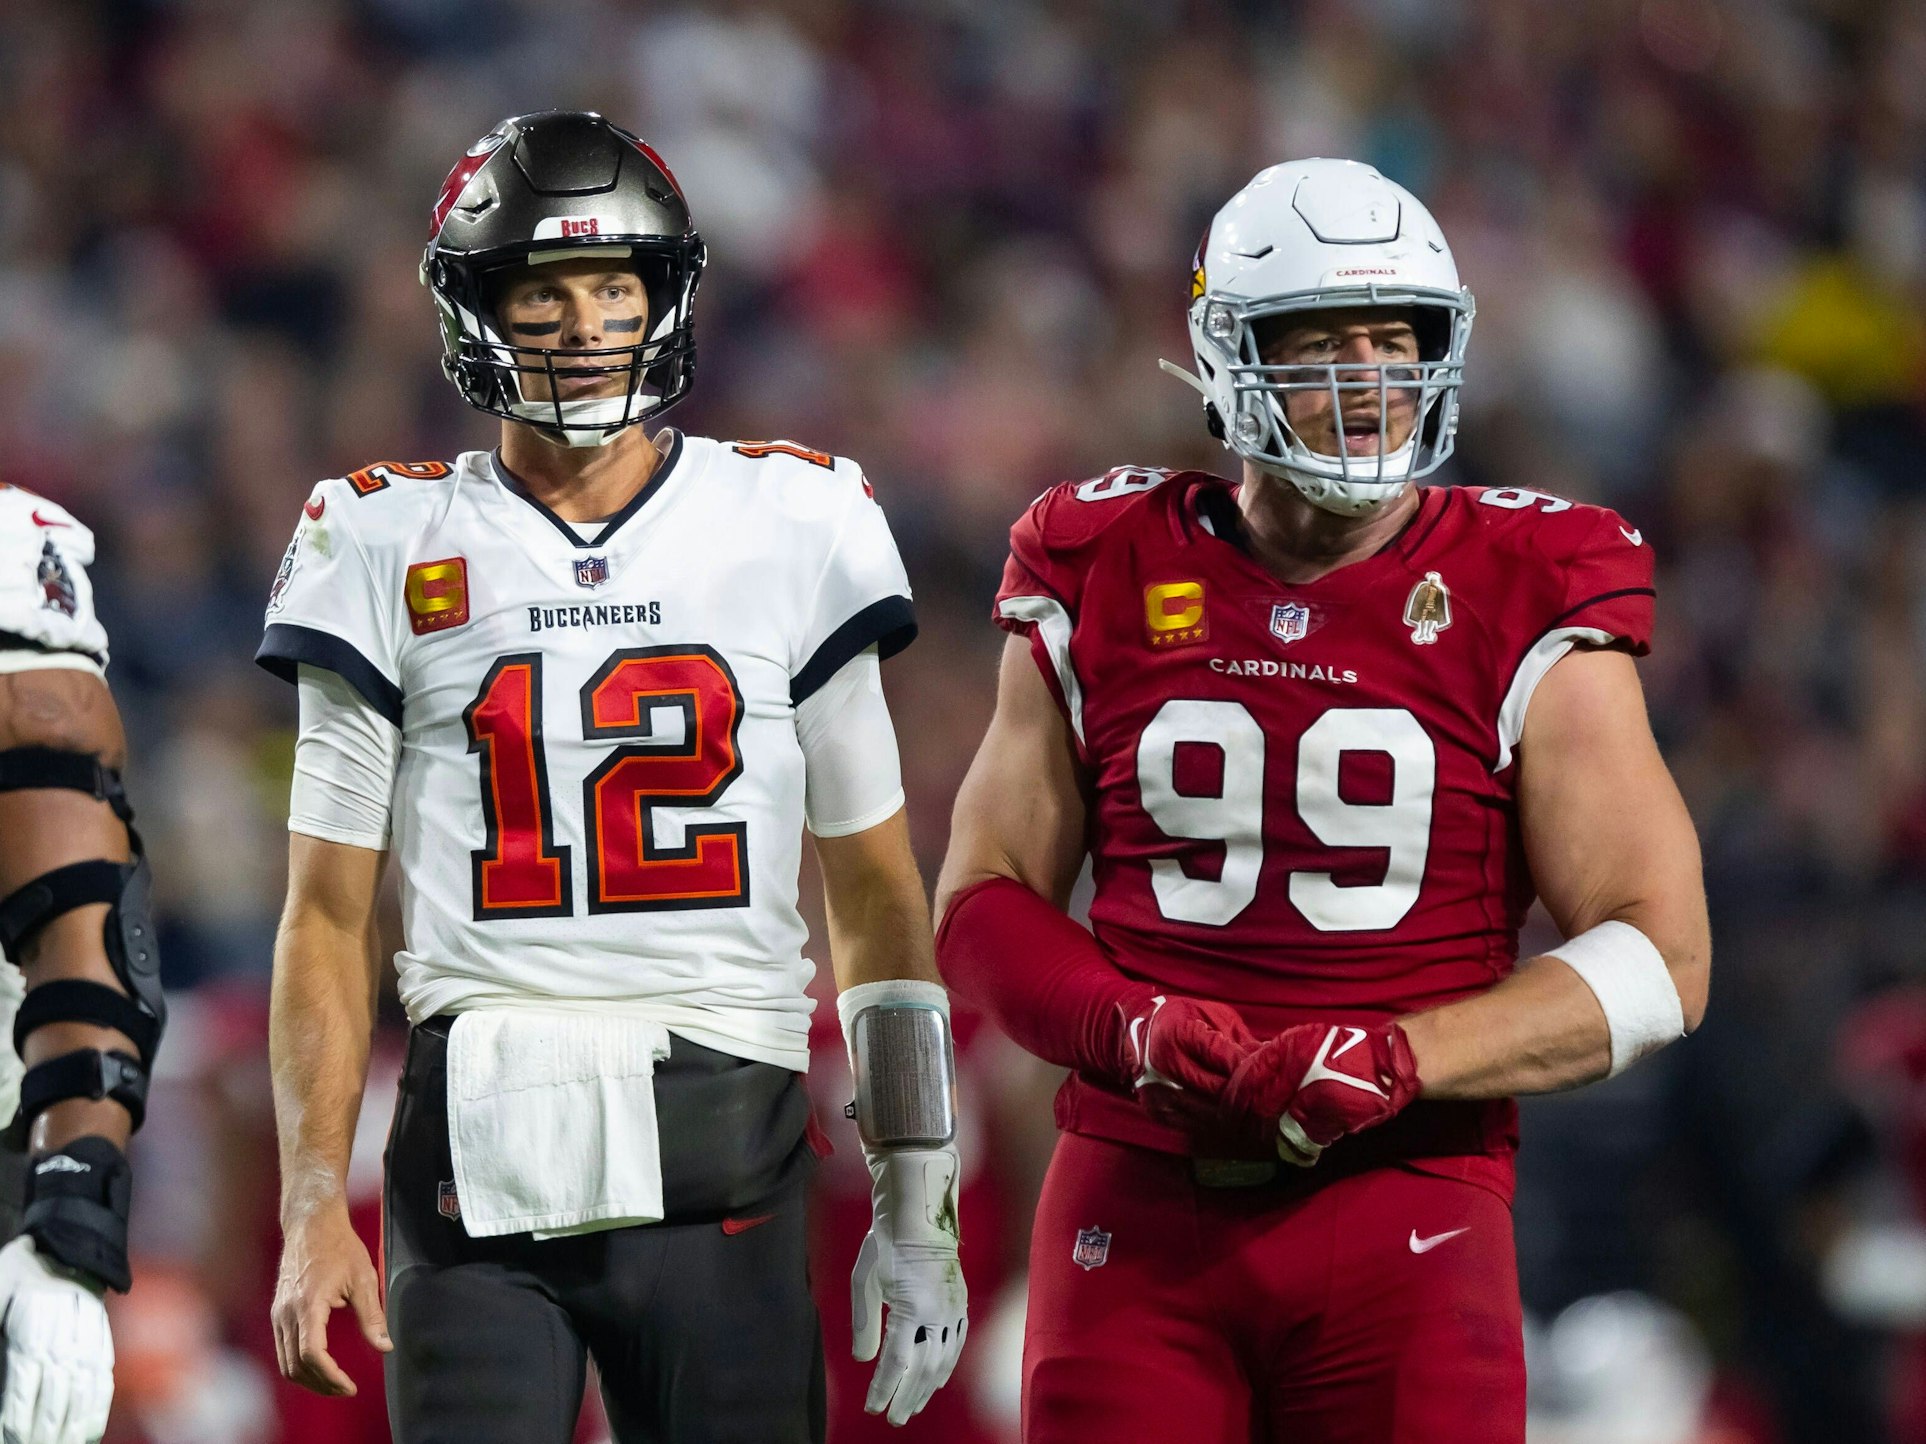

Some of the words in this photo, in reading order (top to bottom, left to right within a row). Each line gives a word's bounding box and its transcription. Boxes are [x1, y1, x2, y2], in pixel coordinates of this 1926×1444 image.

[1336, 269, 1396, 277] CARDINALS
[407, 564, 461, 615] C
[1147, 582, 1203, 631] C
[527, 601, 661, 632] BUCCANEERS
[1209, 658, 1358, 684] CARDINALS
[462, 644, 750, 920] 12
[1137, 700, 1436, 931] 99
